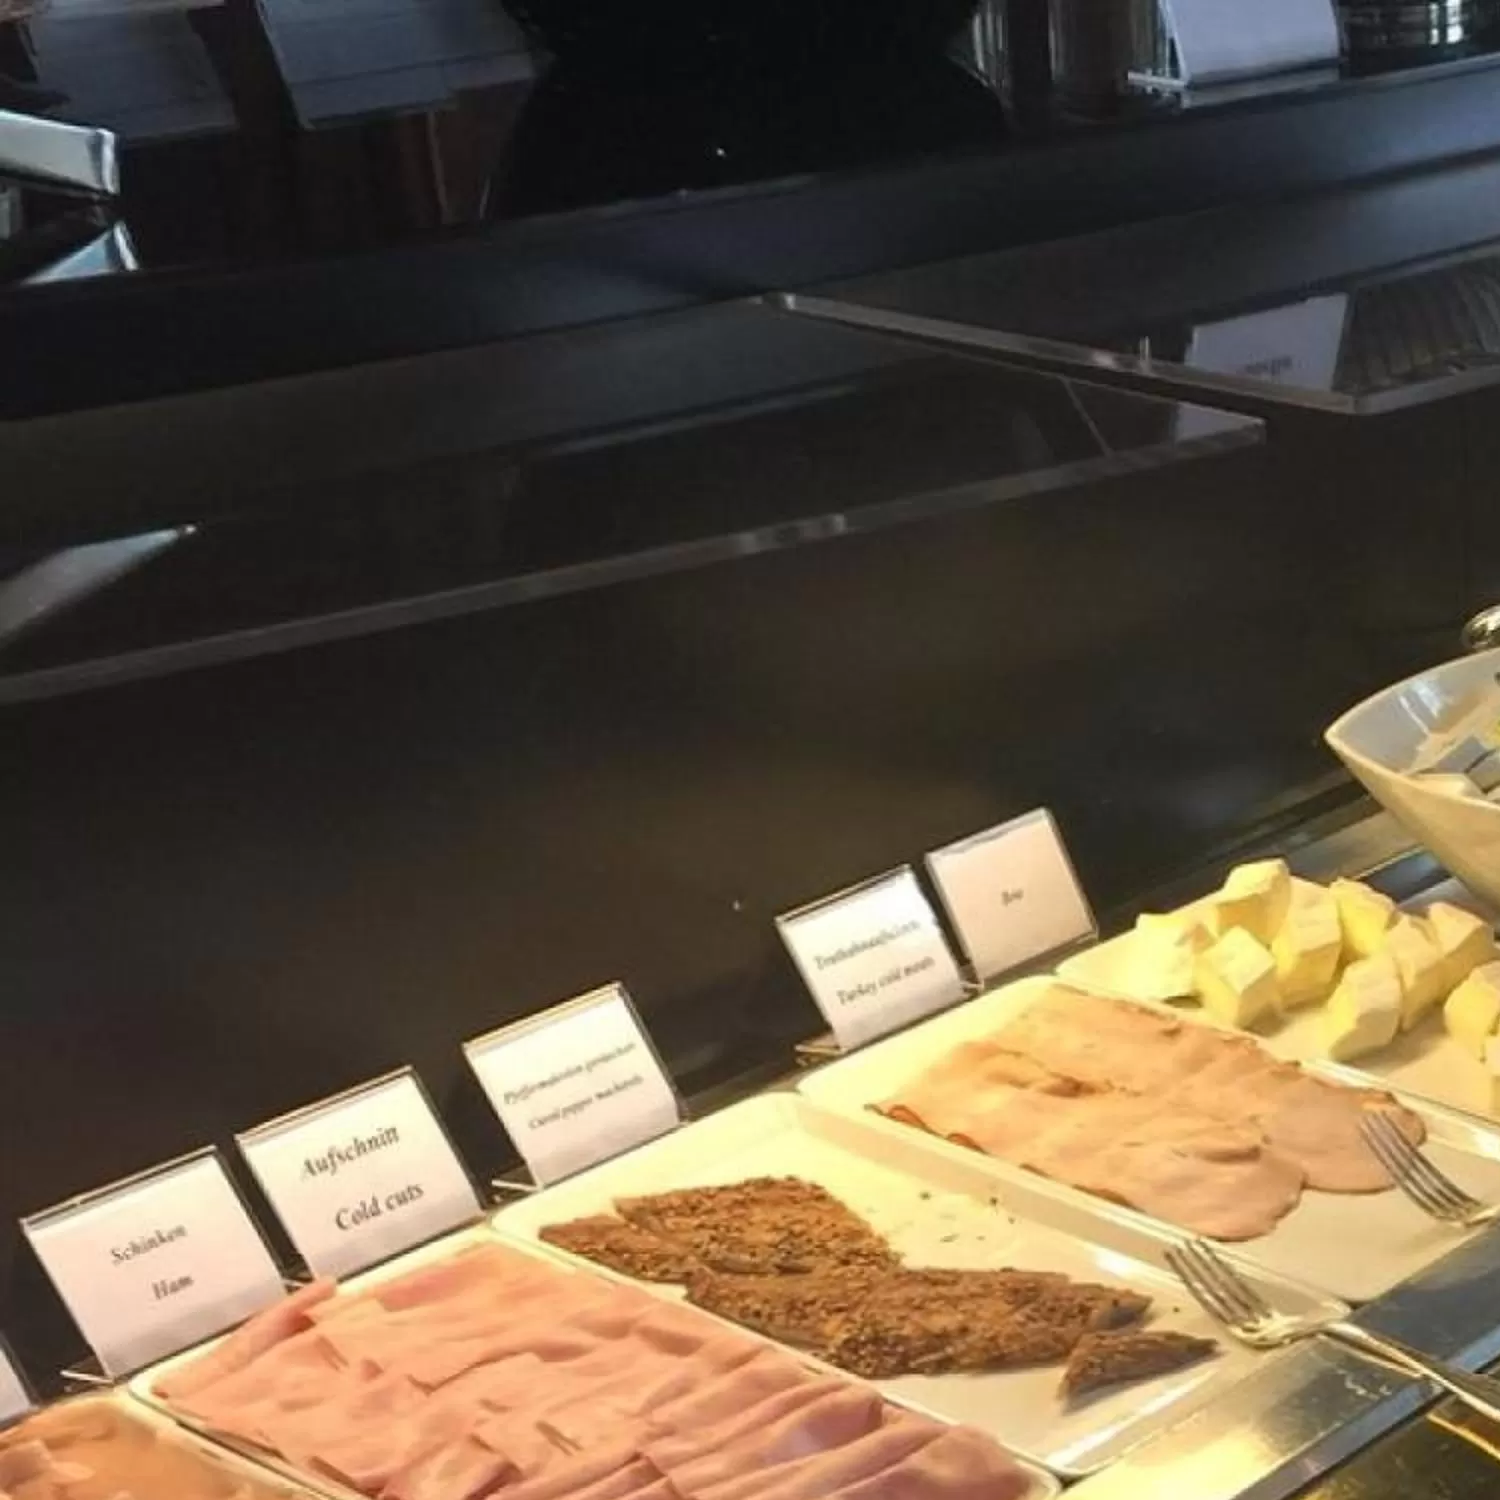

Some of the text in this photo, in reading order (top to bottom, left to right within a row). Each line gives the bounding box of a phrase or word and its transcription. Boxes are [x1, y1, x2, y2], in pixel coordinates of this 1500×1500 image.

[335, 1182, 425, 1230] Cold cuts
[110, 1223, 188, 1264] Schinken
[151, 1273, 195, 1301] Ham
